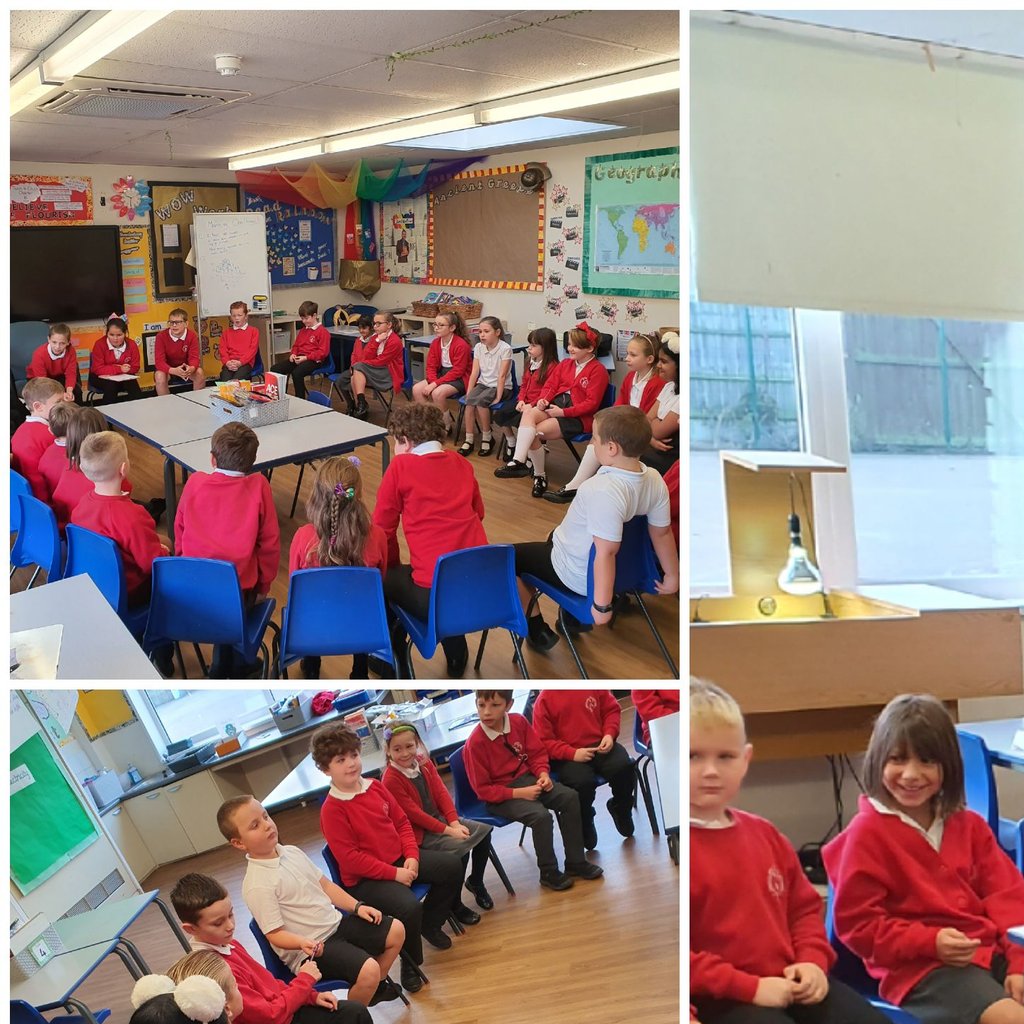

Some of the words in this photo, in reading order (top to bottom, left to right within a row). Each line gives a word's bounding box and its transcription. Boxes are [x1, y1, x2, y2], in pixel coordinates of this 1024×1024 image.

[434, 183, 484, 205] Ancient
[155, 190, 195, 221] WOW
[39, 948, 47, 957] 4
